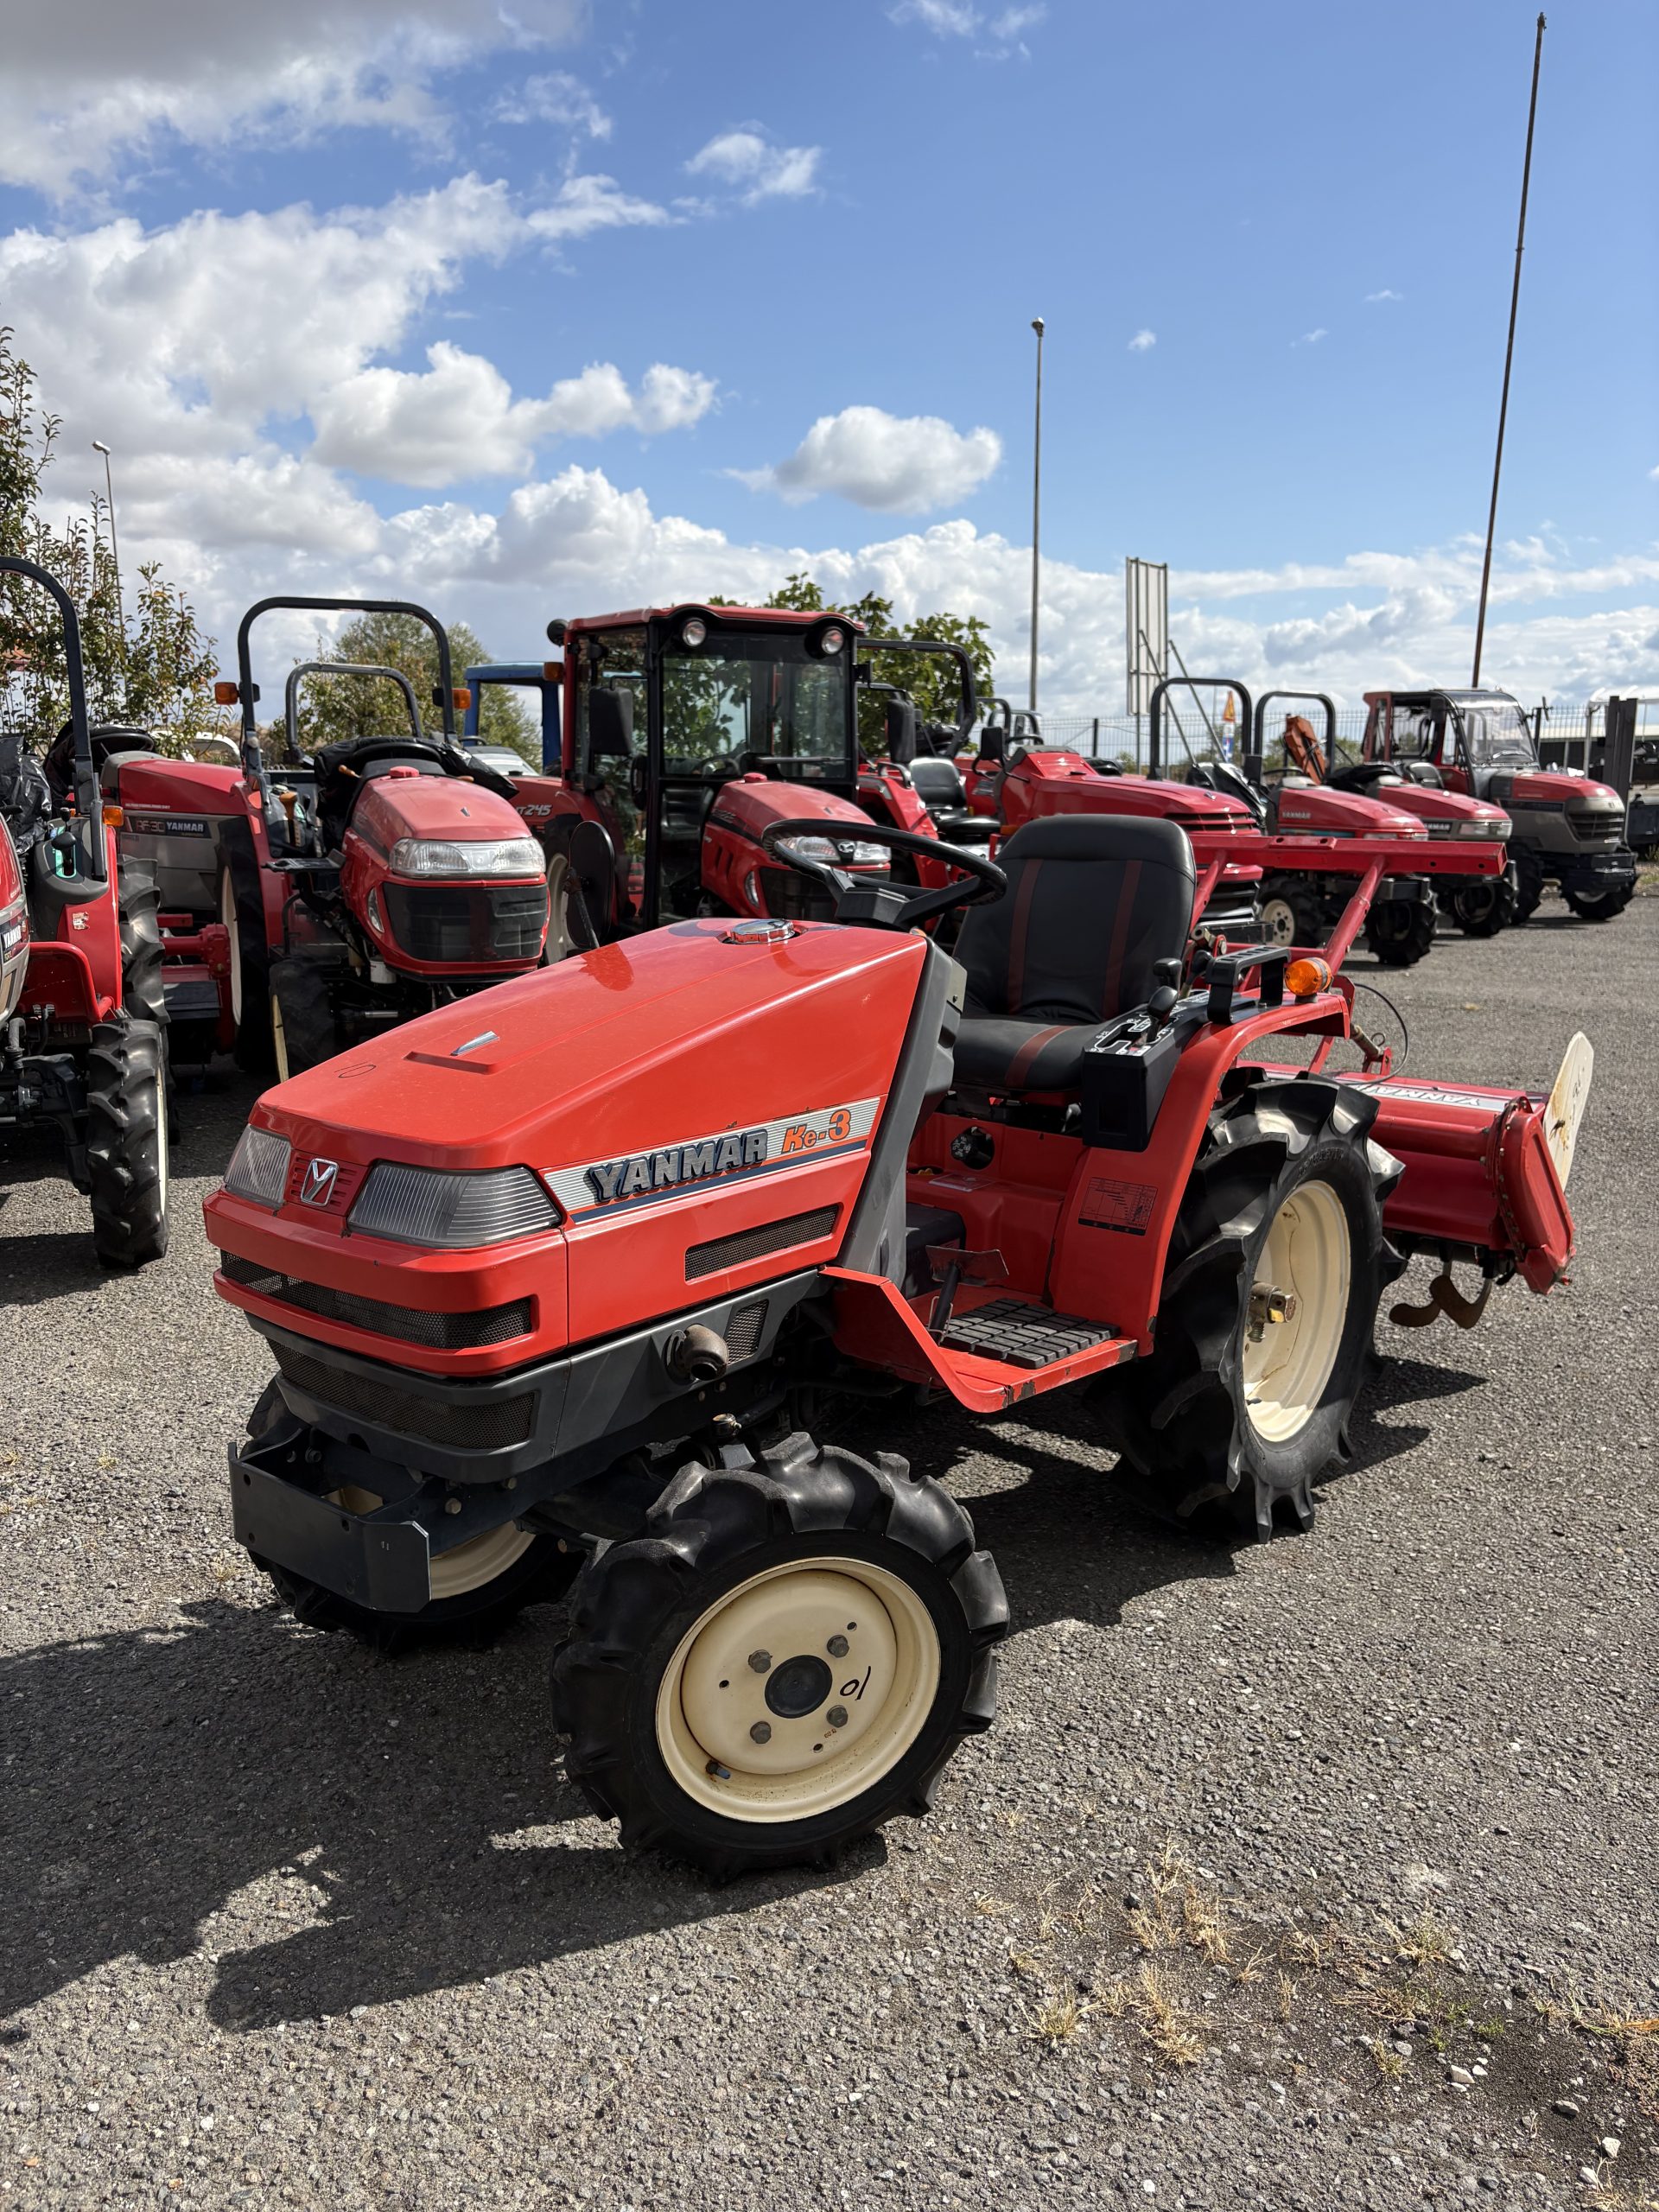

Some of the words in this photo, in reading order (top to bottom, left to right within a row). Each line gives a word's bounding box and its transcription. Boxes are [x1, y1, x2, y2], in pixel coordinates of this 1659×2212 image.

[166, 821, 205, 832] YANMAR
[588, 1128, 768, 1203] YANMAR
[781, 1109, 851, 1154] Ke-3
